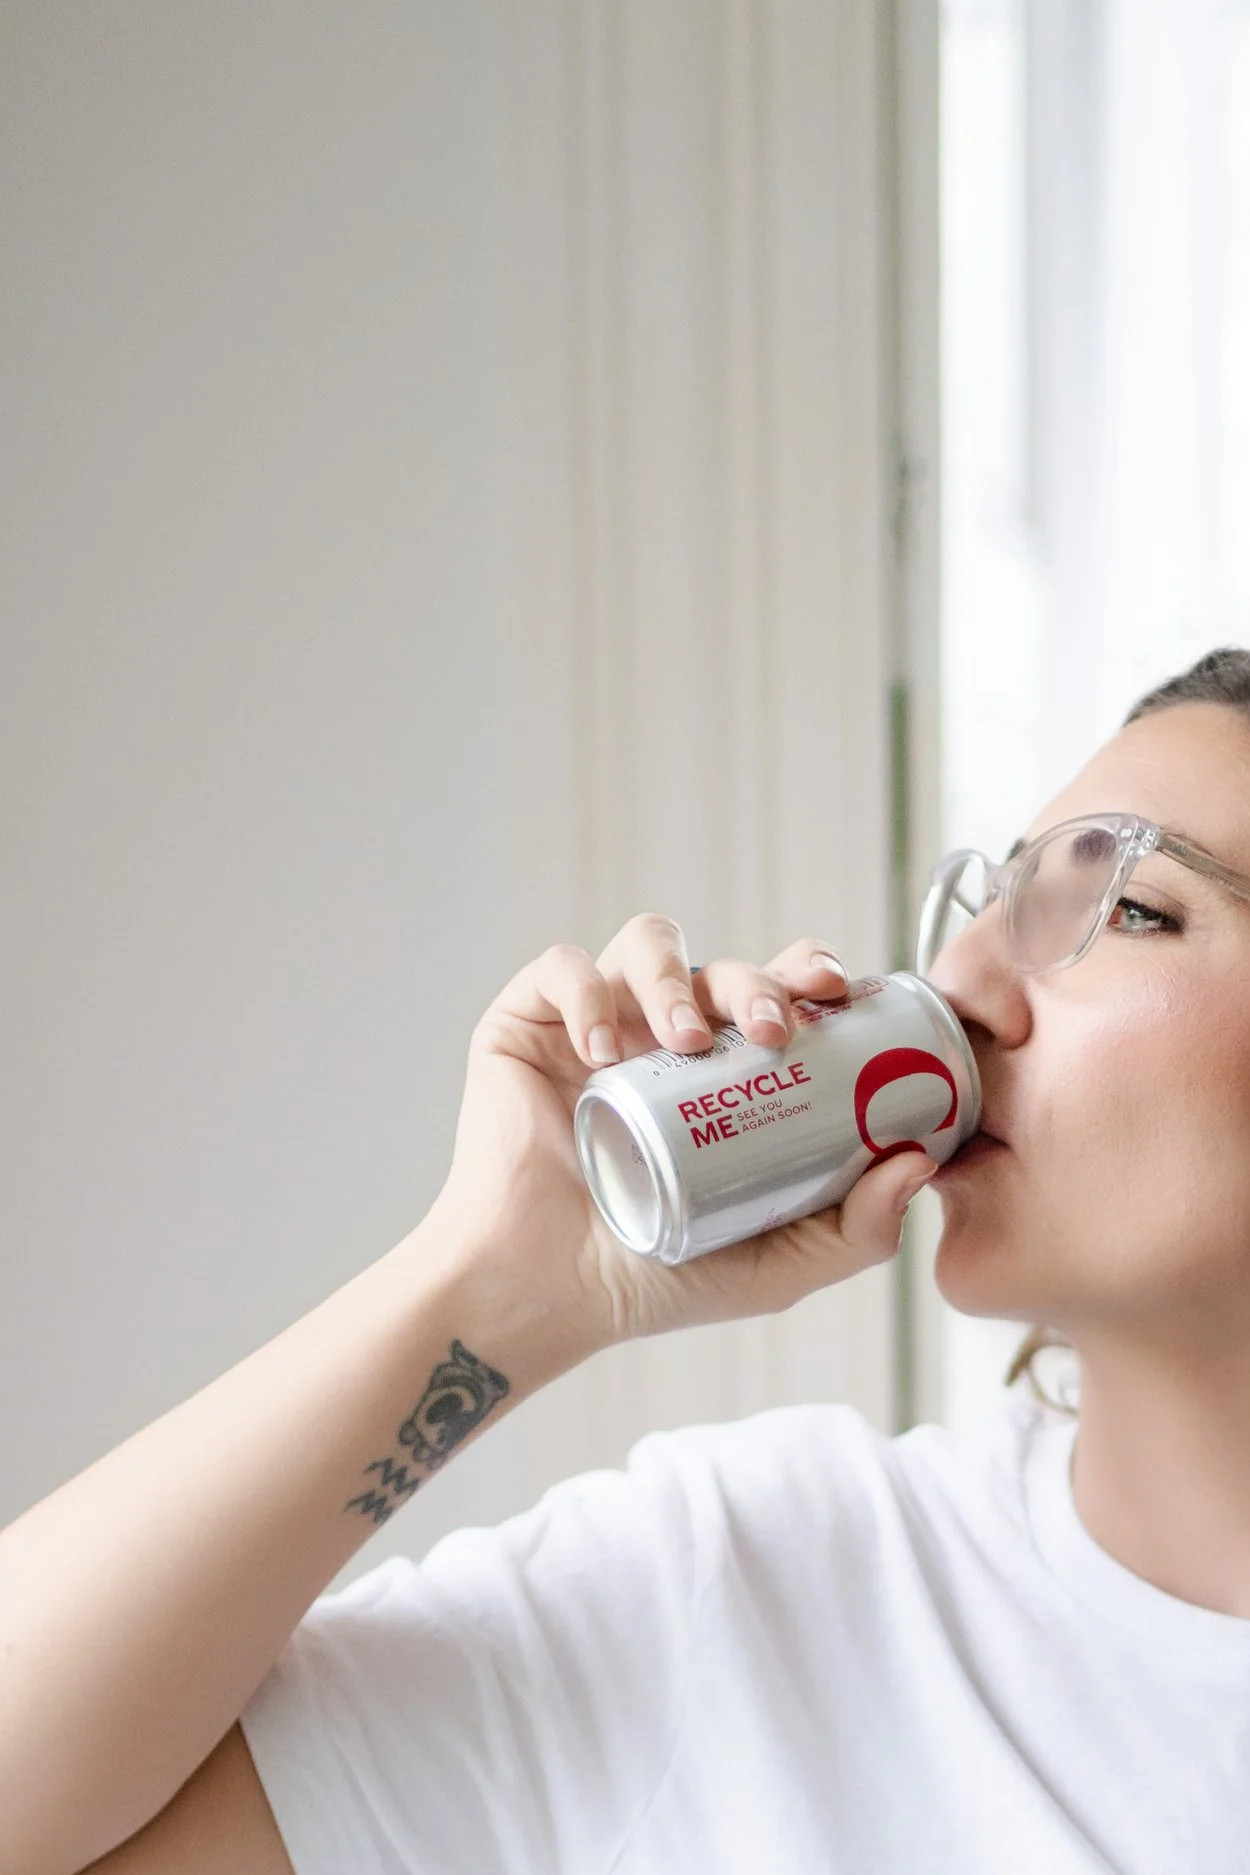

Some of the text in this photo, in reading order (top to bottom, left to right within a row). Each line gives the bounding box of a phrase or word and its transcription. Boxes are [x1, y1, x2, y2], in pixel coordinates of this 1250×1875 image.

[678, 1062, 811, 1123] RECYCLE
[737, 1099, 783, 1122] SEE YOU
[742, 1101, 813, 1133] AGAIN SOON!
[690, 1114, 739, 1149] ME
